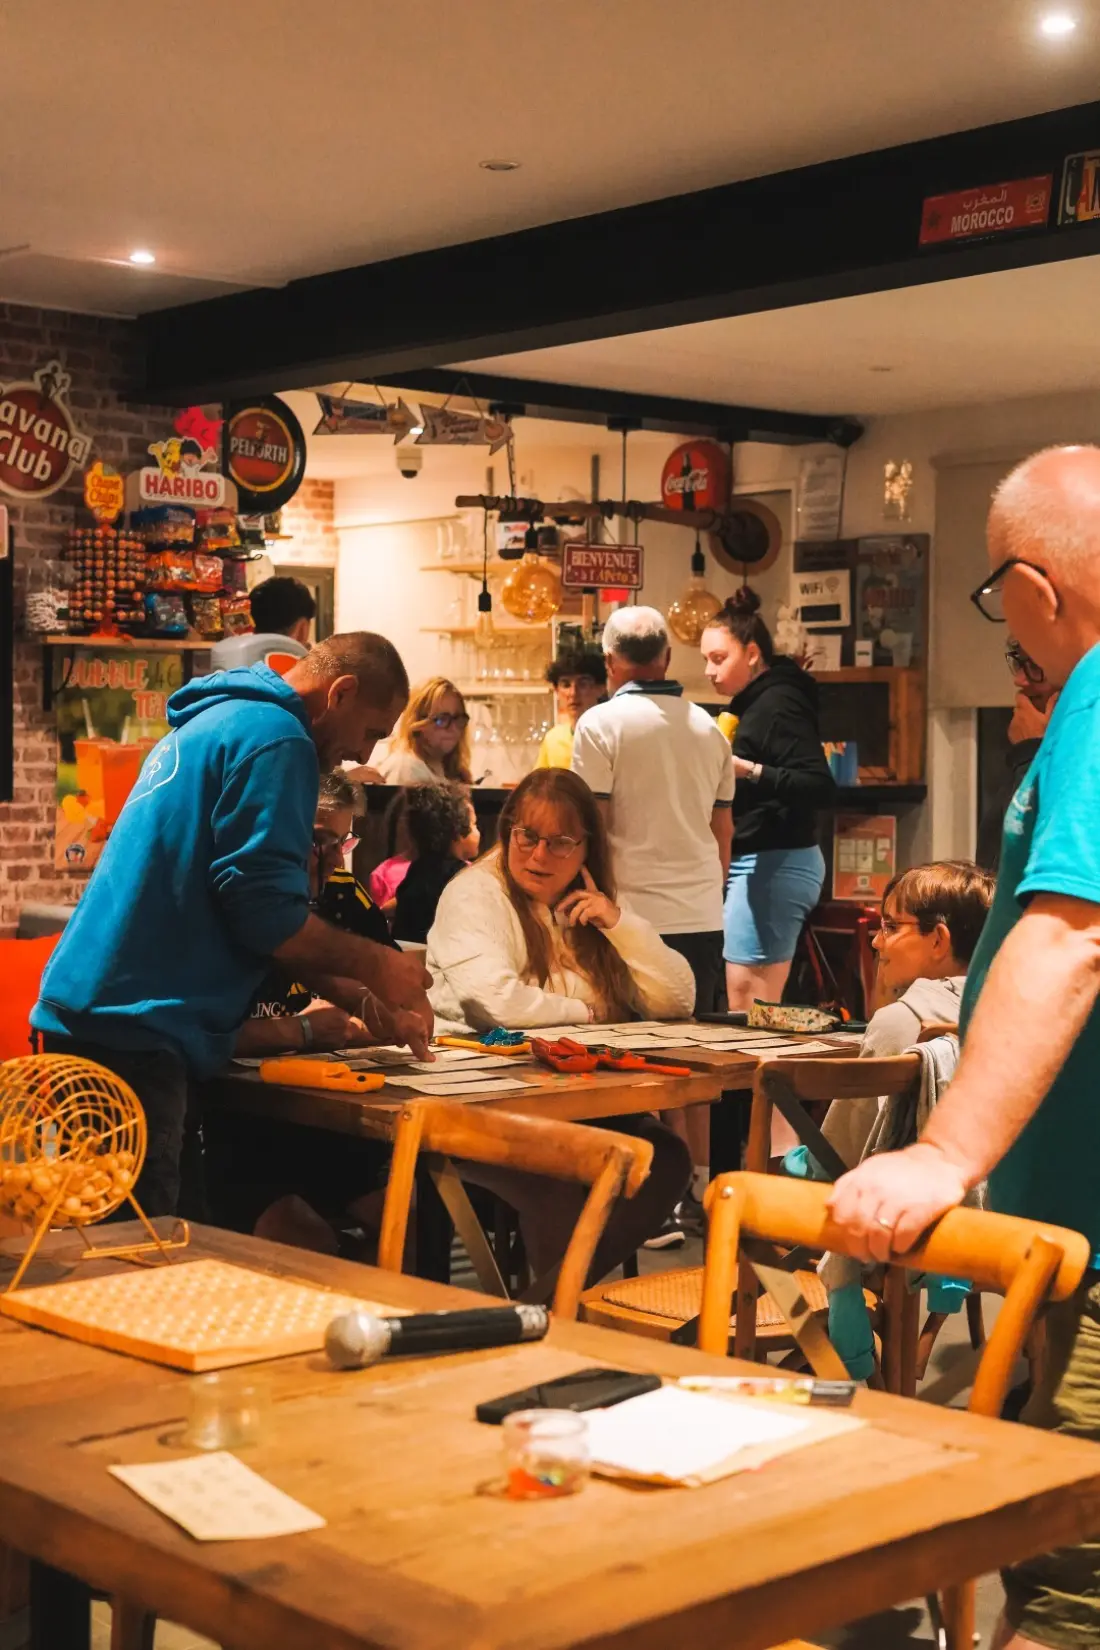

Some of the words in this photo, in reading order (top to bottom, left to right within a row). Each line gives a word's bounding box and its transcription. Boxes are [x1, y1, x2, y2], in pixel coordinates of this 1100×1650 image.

[962, 188, 1008, 211] المغرب
[950, 205, 1015, 234] MOROCCO
[0, 429, 52, 482] Club
[229, 436, 288, 464] PELFORTH
[145, 473, 218, 500] HARIBO
[571, 550, 637, 569] BIENVENUE
